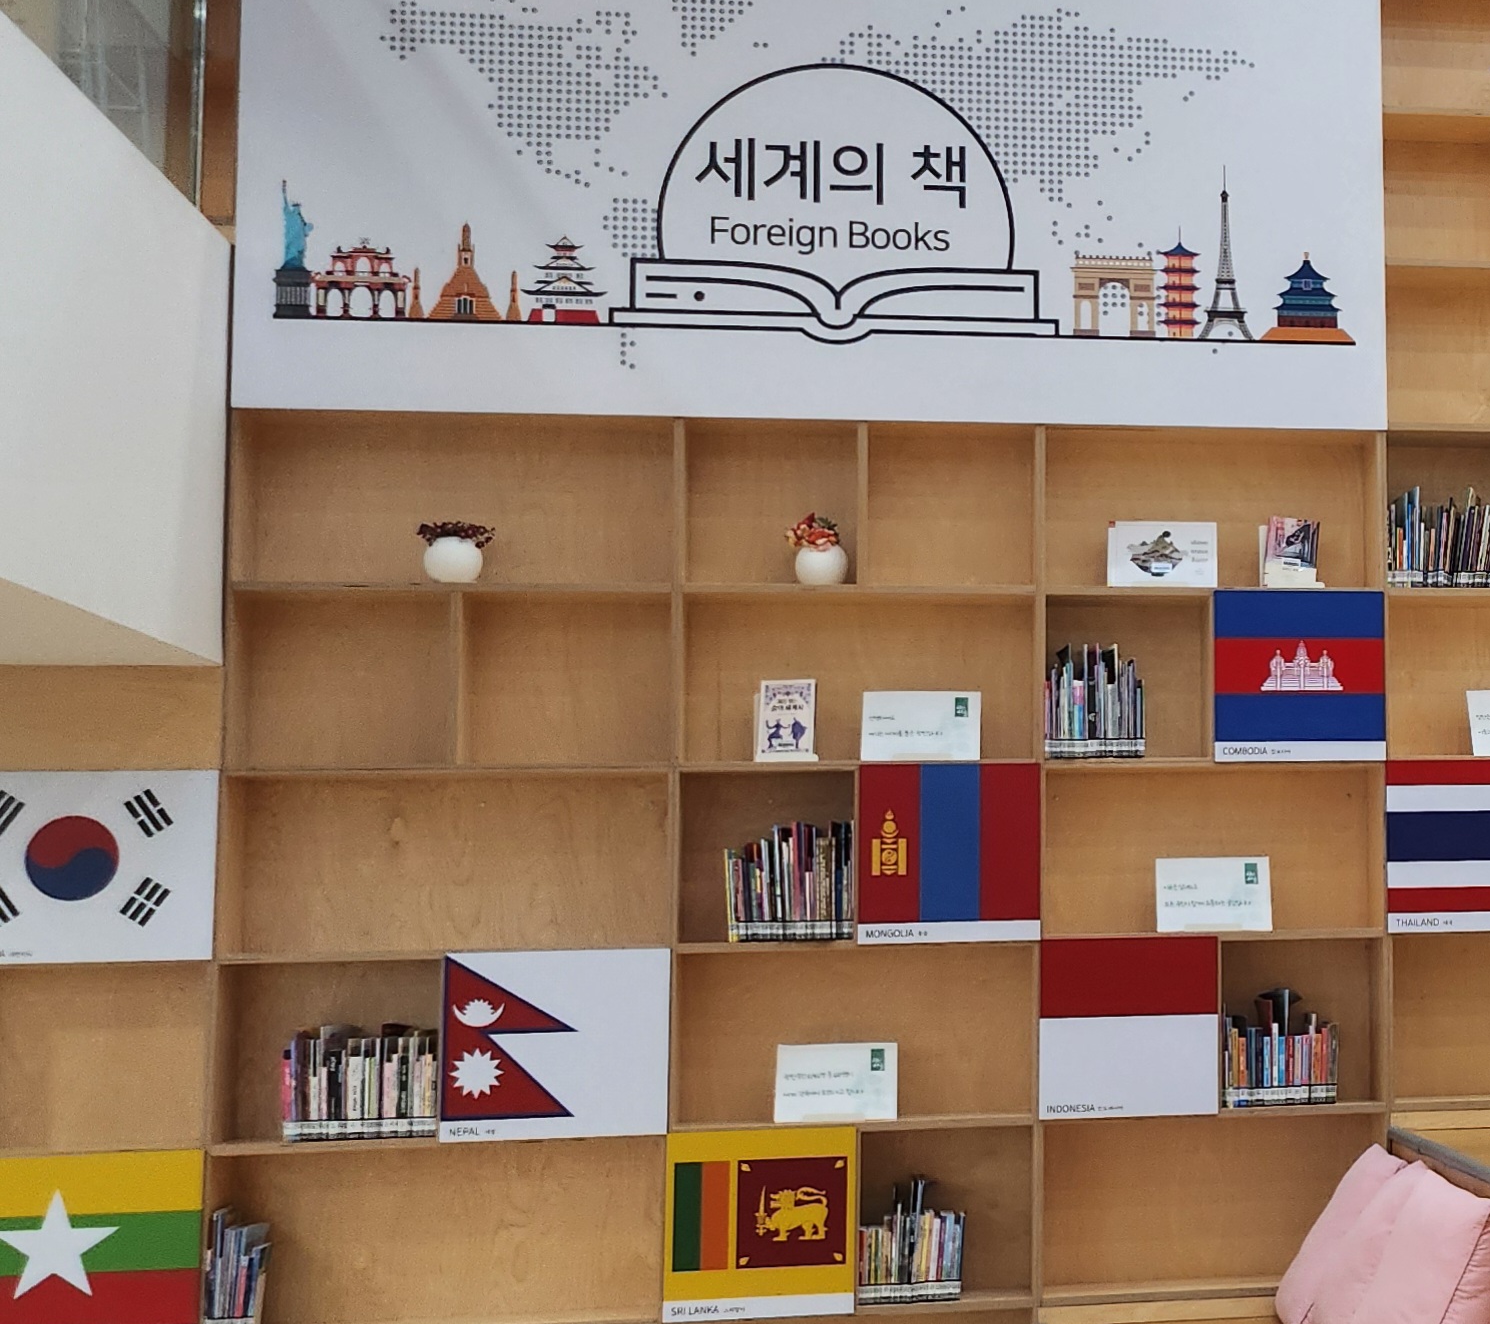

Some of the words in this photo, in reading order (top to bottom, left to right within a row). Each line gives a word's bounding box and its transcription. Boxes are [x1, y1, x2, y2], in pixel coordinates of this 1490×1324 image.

[695, 137, 884, 206] 세계의
[911, 144, 966, 209] 책
[710, 216, 838, 255] Foreign
[849, 220, 951, 252] Books
[1396, 917, 1440, 927] THAILAND
[865, 928, 914, 938] MONGOLIA
[1046, 1104, 1095, 1114] INDONESIA
[449, 1126, 480, 1137] NEPAL
[671, 1306, 686, 1316] SRI
[688, 1305, 720, 1316] LANKA
